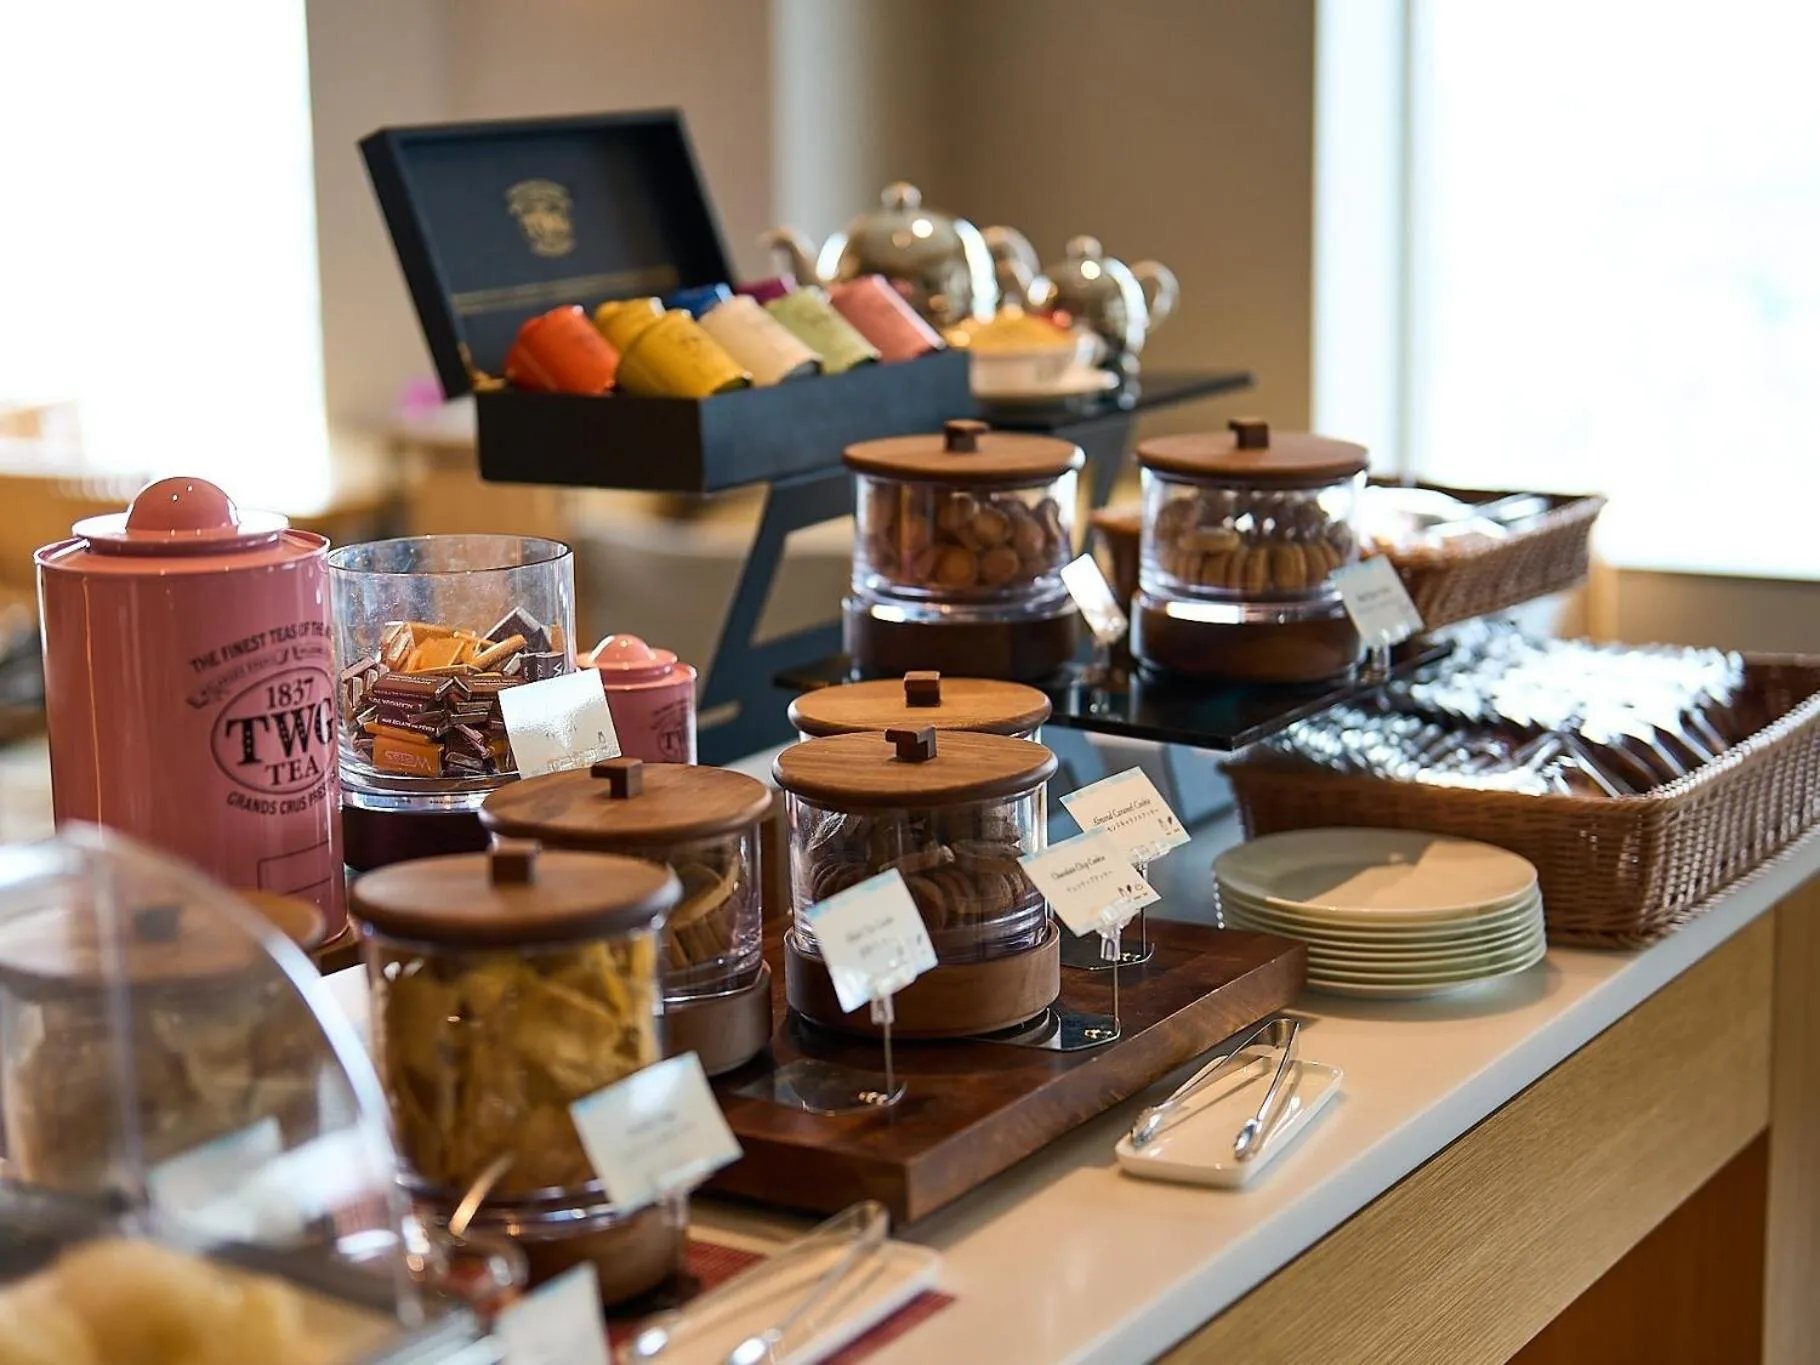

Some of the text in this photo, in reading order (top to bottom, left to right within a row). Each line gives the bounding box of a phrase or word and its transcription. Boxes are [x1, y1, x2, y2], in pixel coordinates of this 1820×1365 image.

[190, 650, 221, 674] THE
[221, 632, 266, 661] FINEST
[268, 624, 297, 645] TEAS
[297, 621, 310, 637] OF
[266, 677, 314, 710] 1837
[224, 697, 334, 766] TWG
[264, 754, 319, 786] TEA
[226, 790, 277, 815] GRANDS
[279, 795, 308, 815] CRUS
